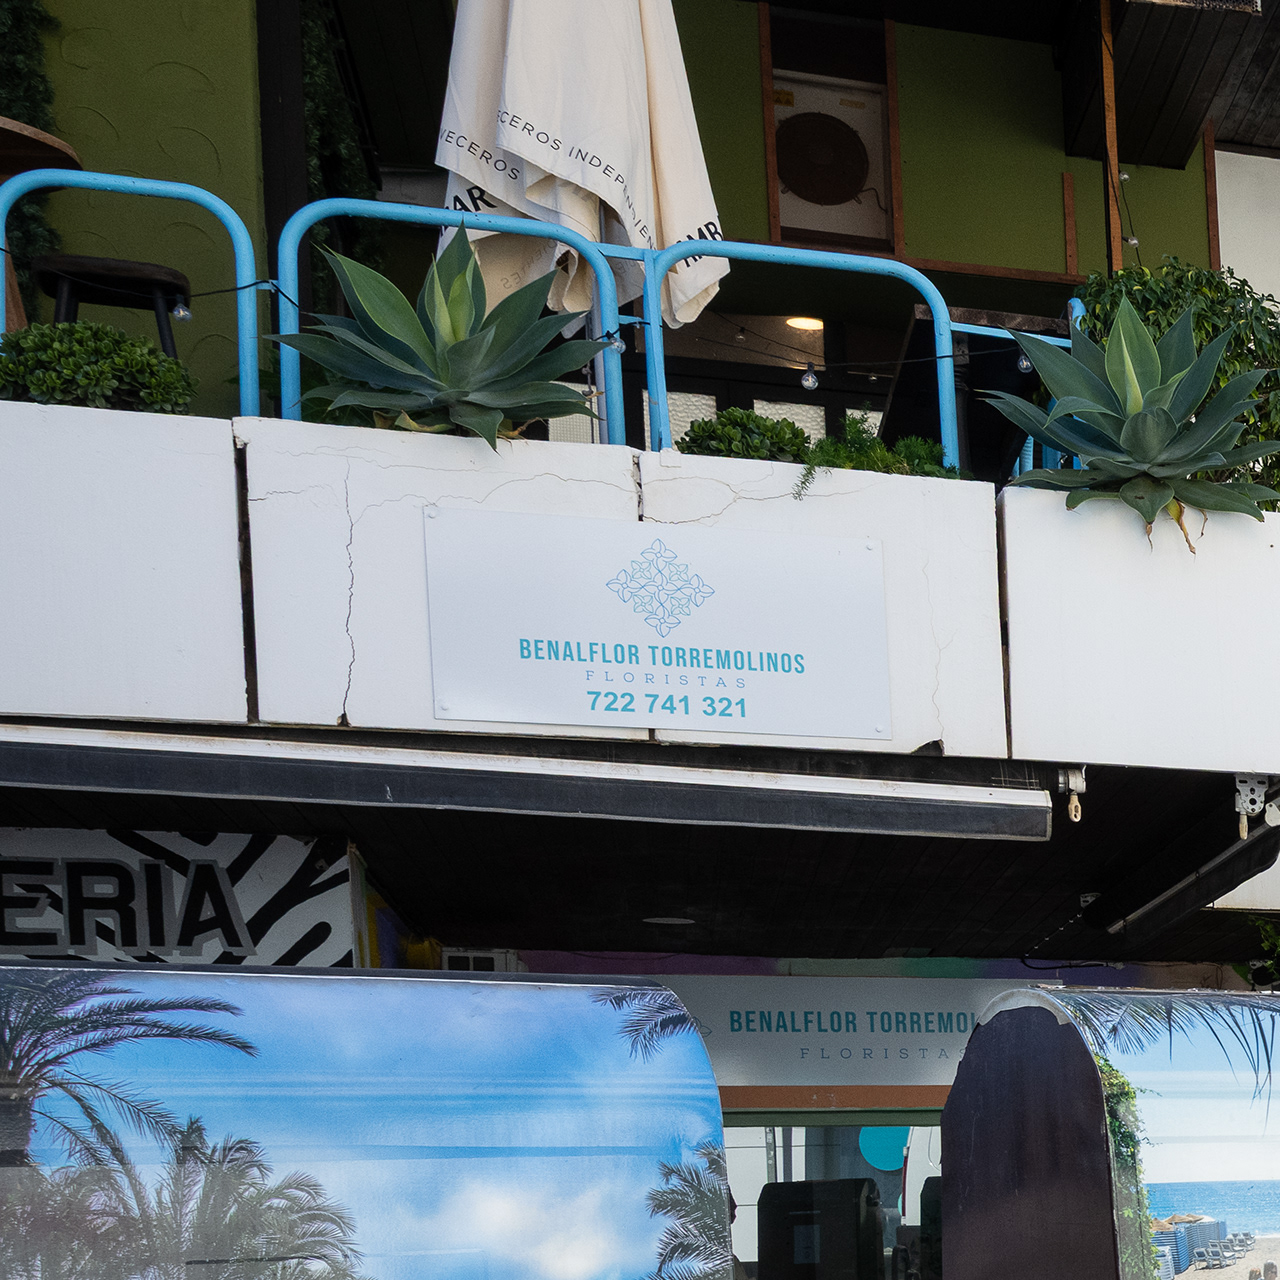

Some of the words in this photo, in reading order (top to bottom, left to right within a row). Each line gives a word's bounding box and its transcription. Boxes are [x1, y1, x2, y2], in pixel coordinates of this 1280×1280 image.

[519, 638, 640, 667] BENALFLOR
[647, 645, 806, 675] TORREMOLINOS
[586, 670, 747, 689] FLORISTAS
[586, 690, 636, 713] 722
[644, 694, 691, 716] 741
[702, 697, 746, 718] 321
[729, 1010, 858, 1033] BENALFLOR
